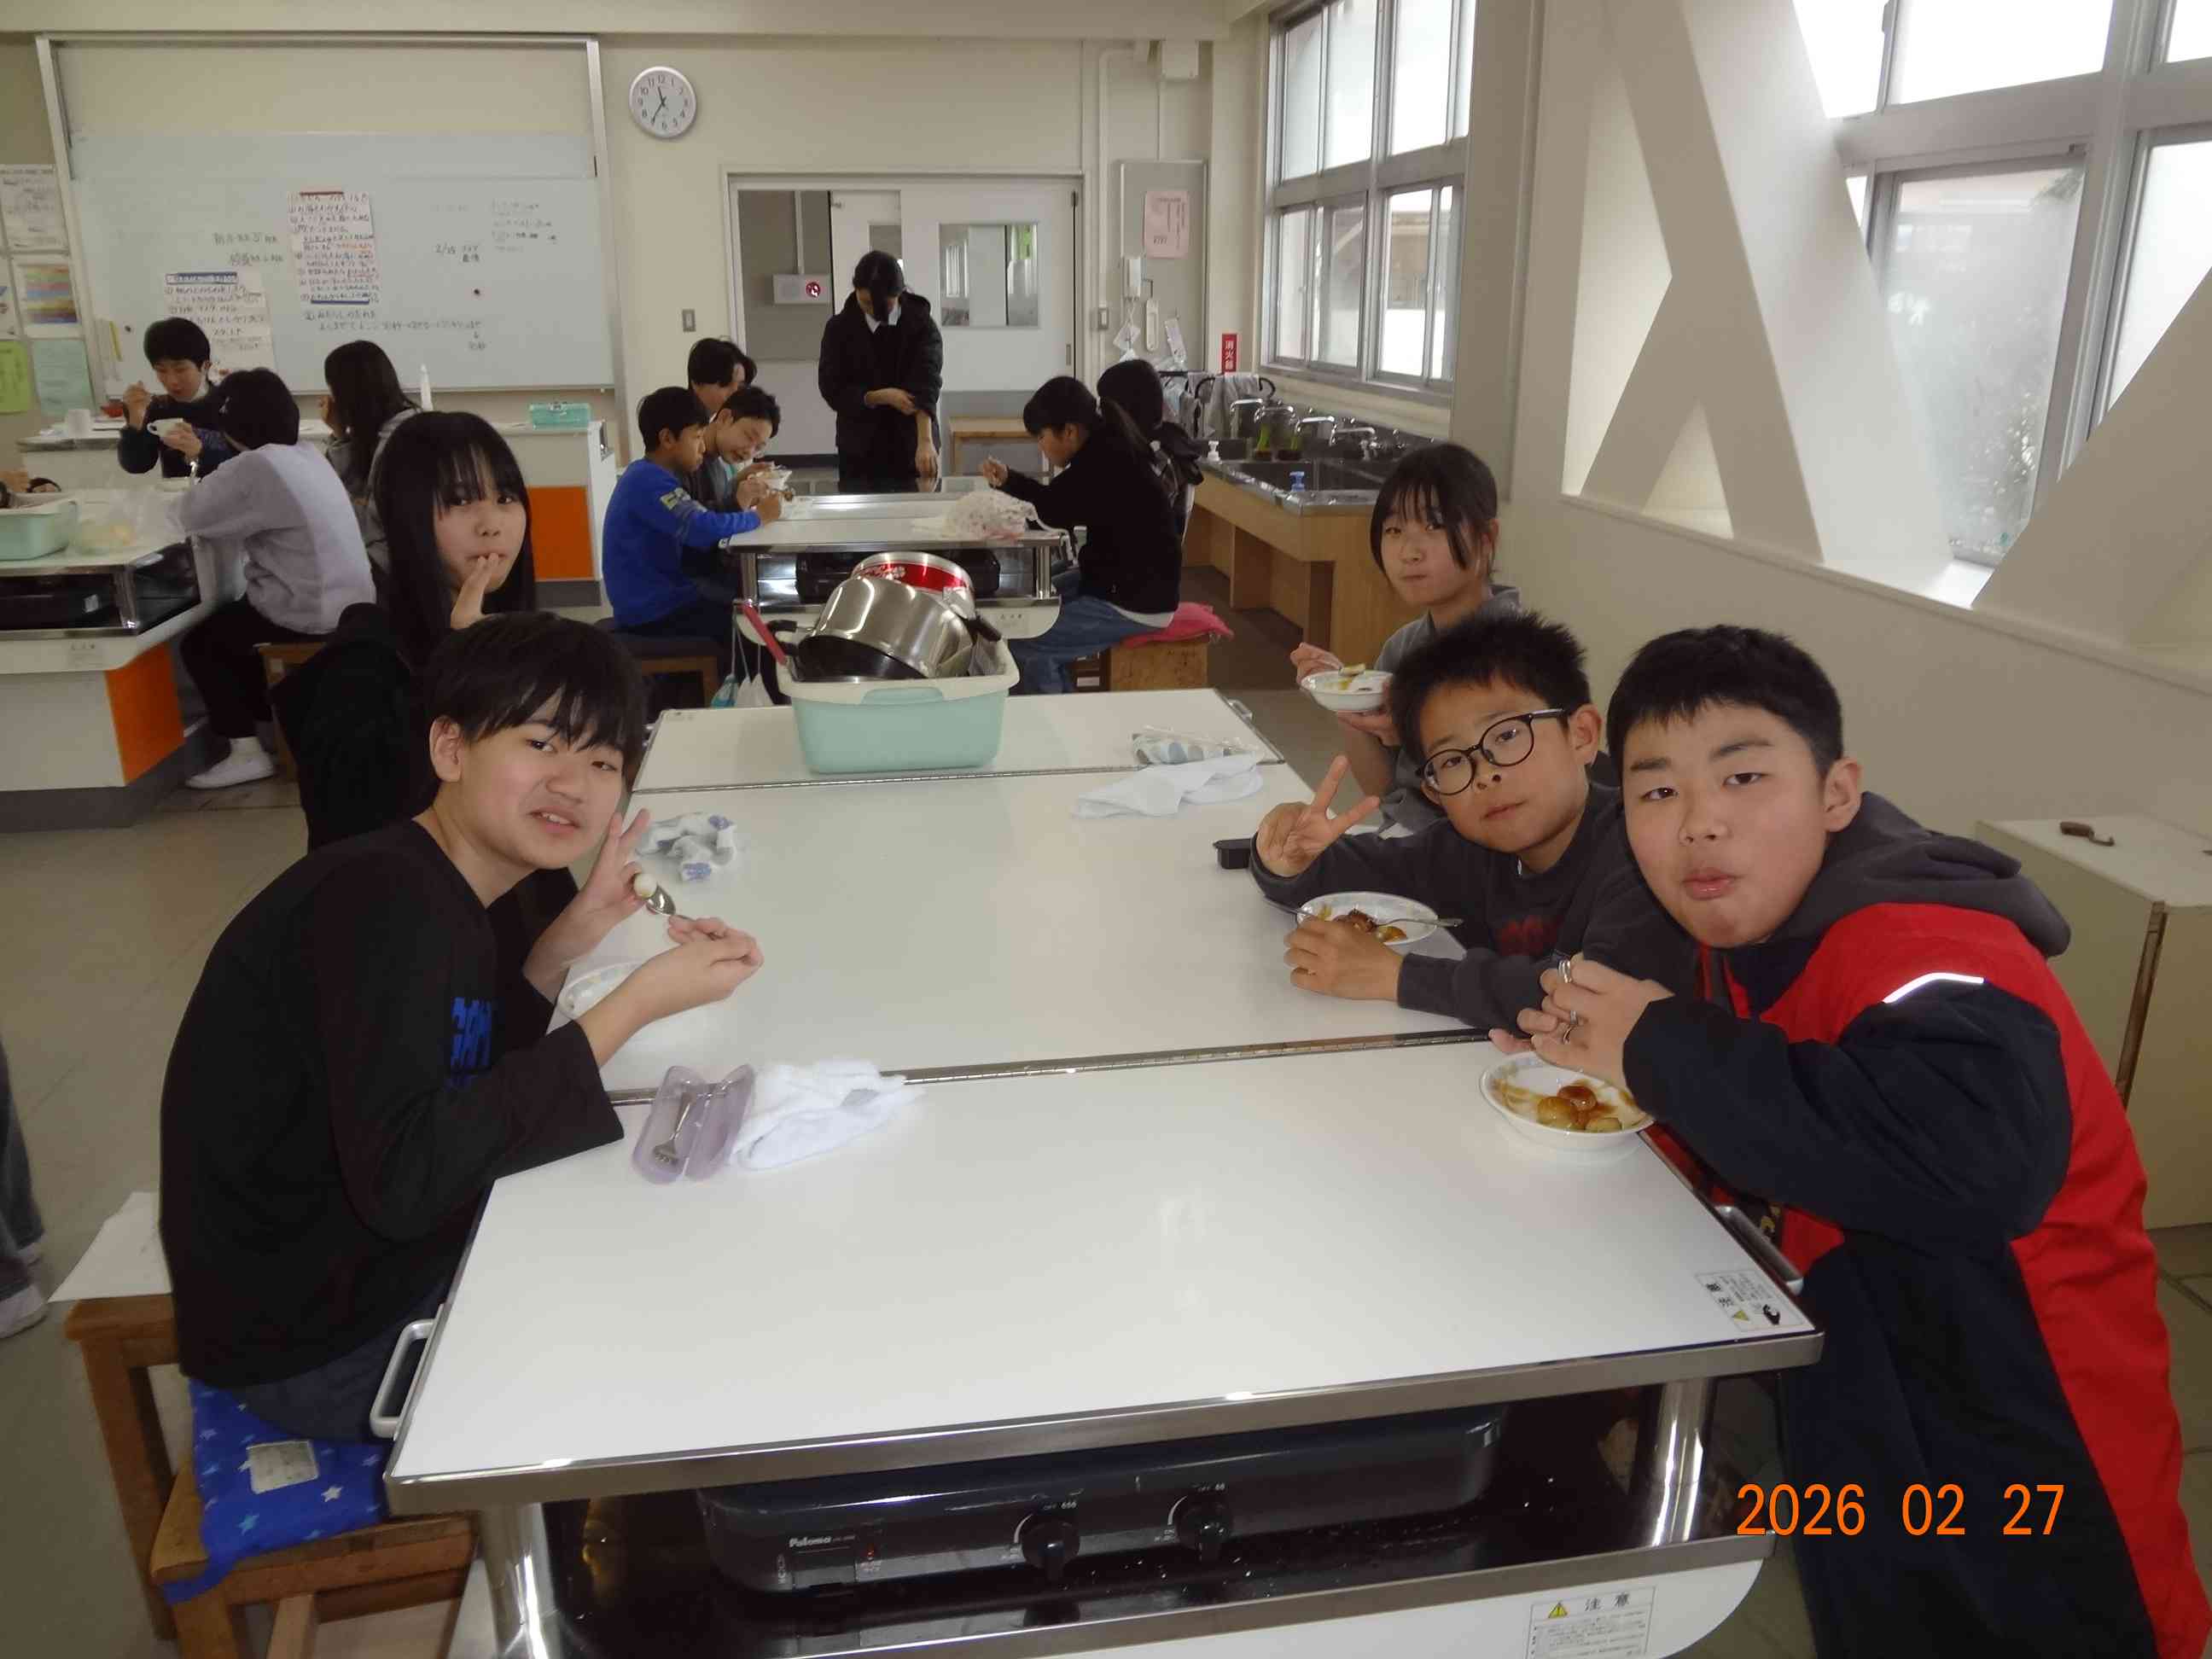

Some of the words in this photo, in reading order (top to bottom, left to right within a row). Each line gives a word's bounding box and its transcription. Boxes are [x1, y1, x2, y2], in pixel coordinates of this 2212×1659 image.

[648, 78, 655, 87] 11
[658, 75, 666, 84] 12
[641, 87, 649, 96] 10
[788, 1535, 833, 1548] Paloma
